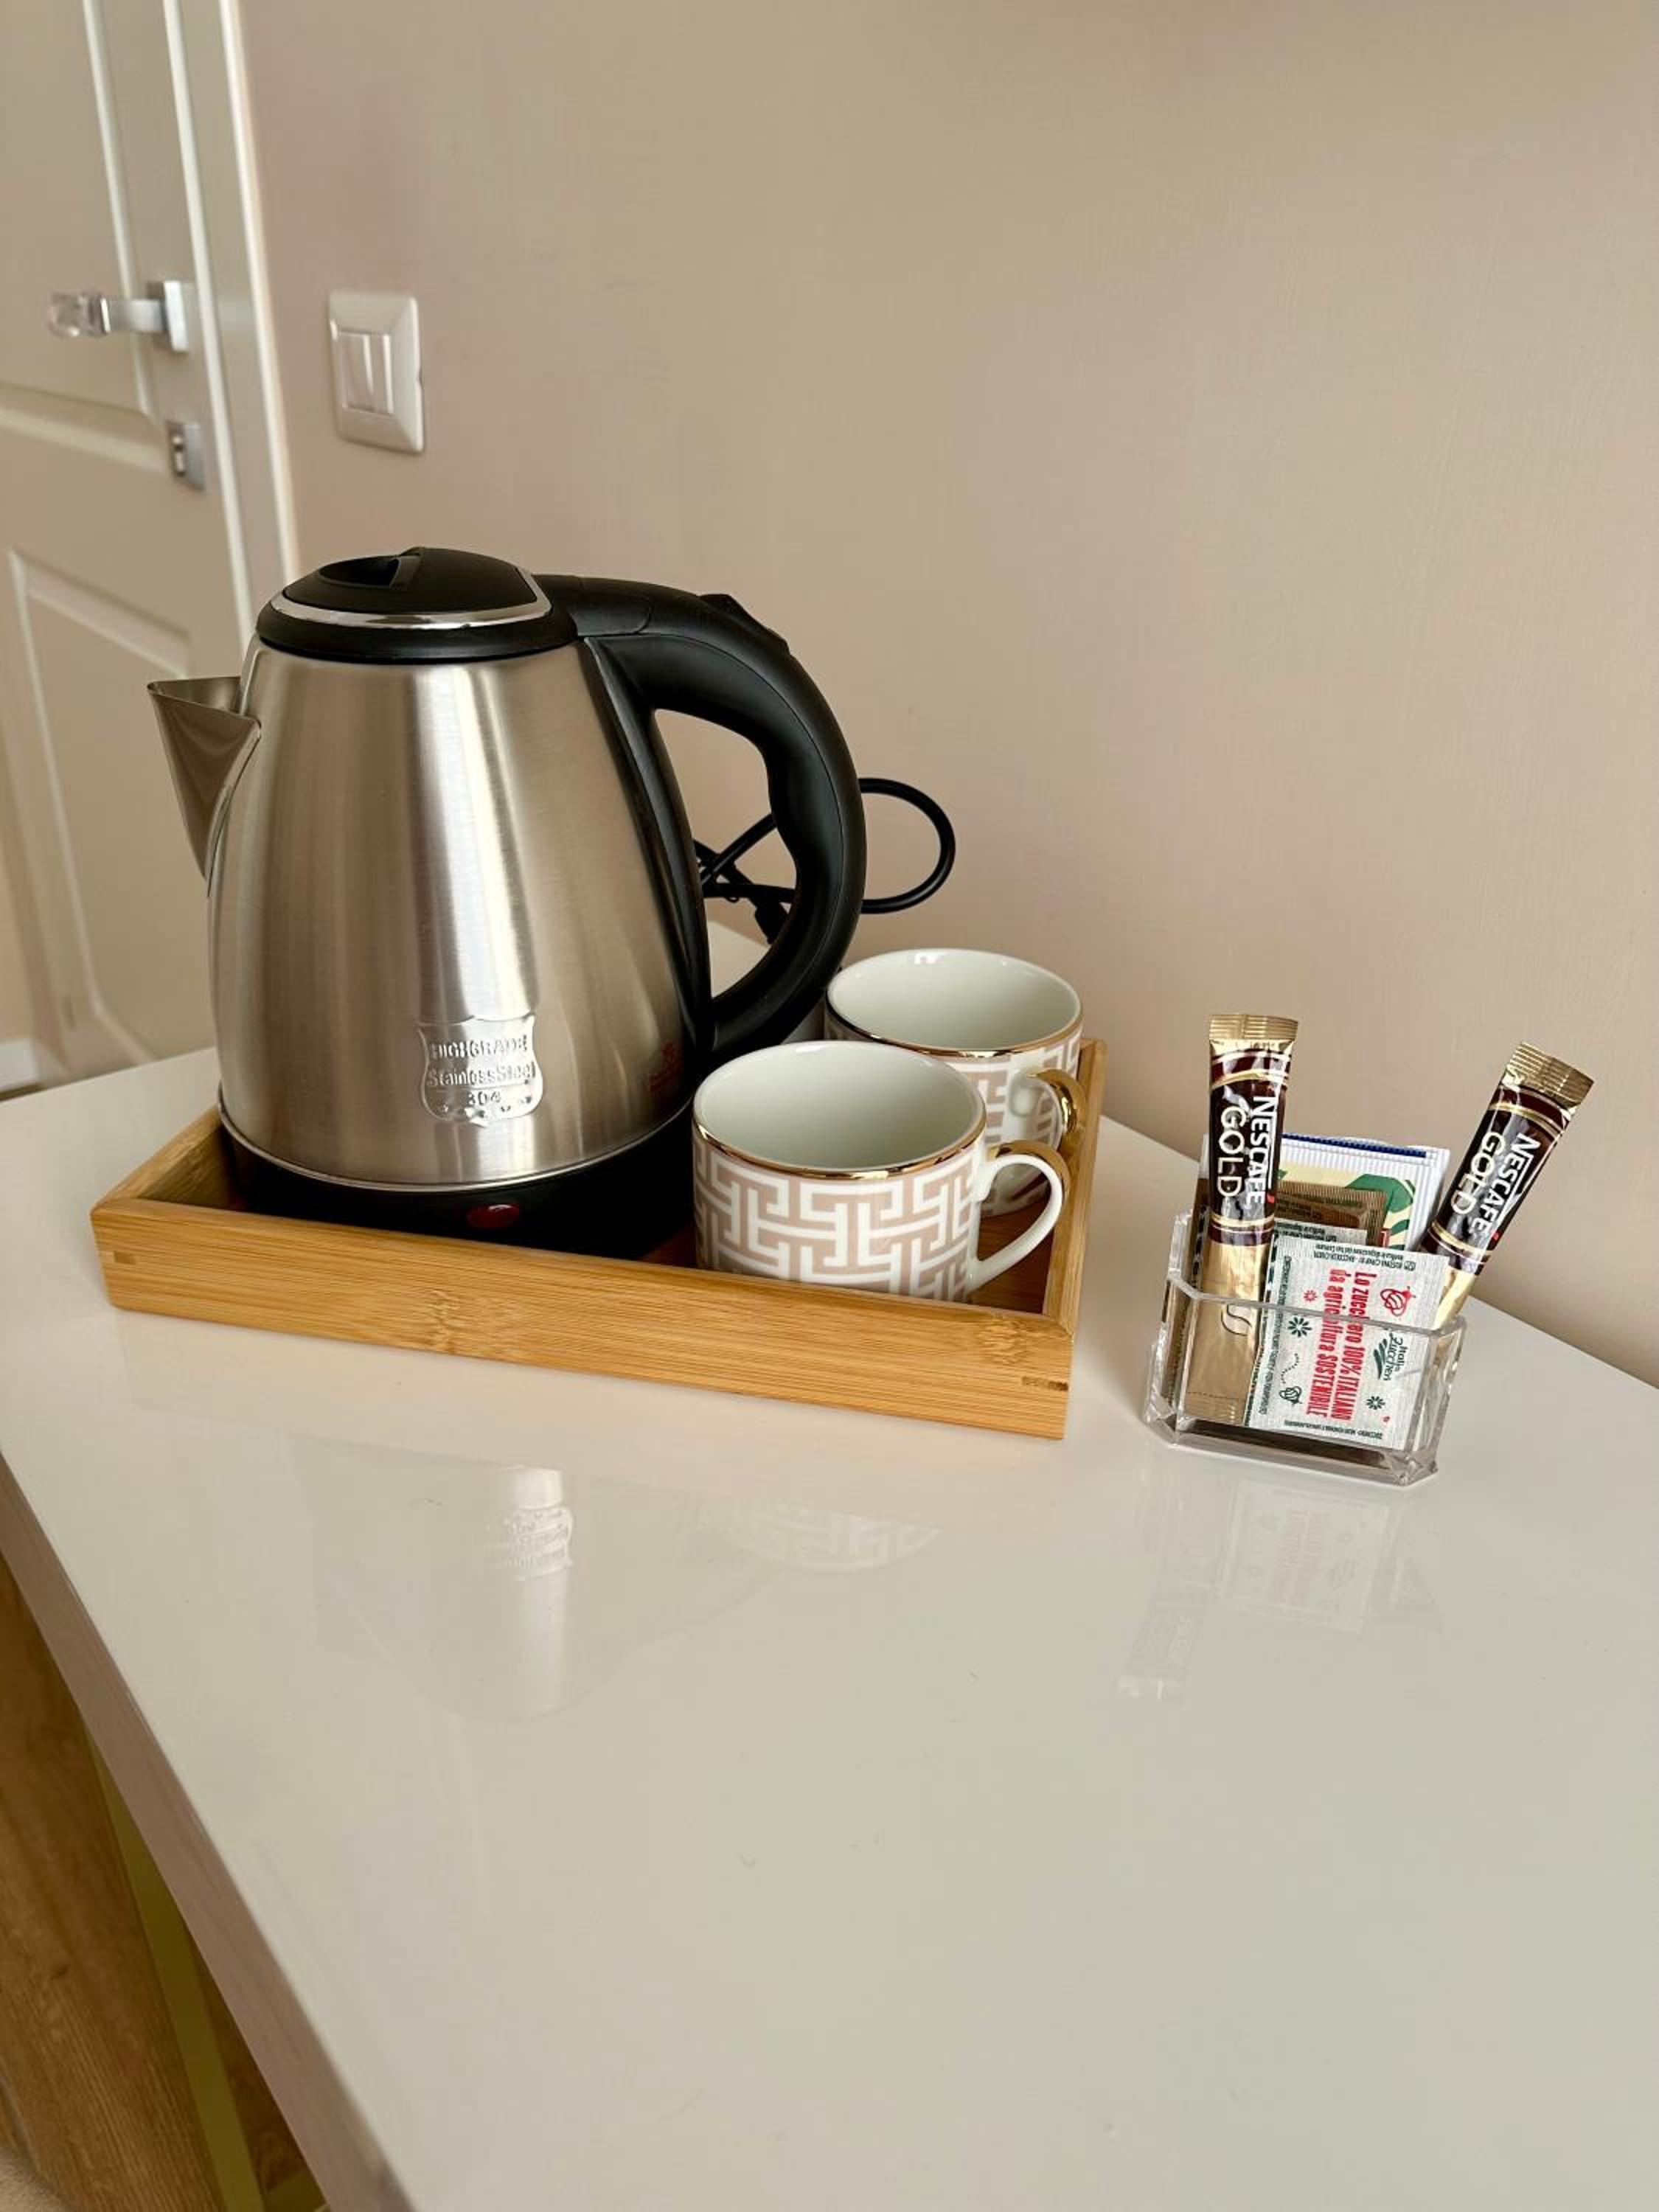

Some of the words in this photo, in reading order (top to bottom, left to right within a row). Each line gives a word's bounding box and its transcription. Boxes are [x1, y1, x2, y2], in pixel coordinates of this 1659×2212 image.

[1218, 1106, 1247, 1197] GOLD
[1451, 1132, 1506, 1214] GOLD
[1329, 1269, 1352, 1282] da
[1353, 1270, 1377, 1287] Lo
[1340, 1346, 1365, 1375] 100%
[1306, 1354, 1338, 1418] SOSTENIBILE
[1329, 1374, 1360, 1421] ITALIANO
